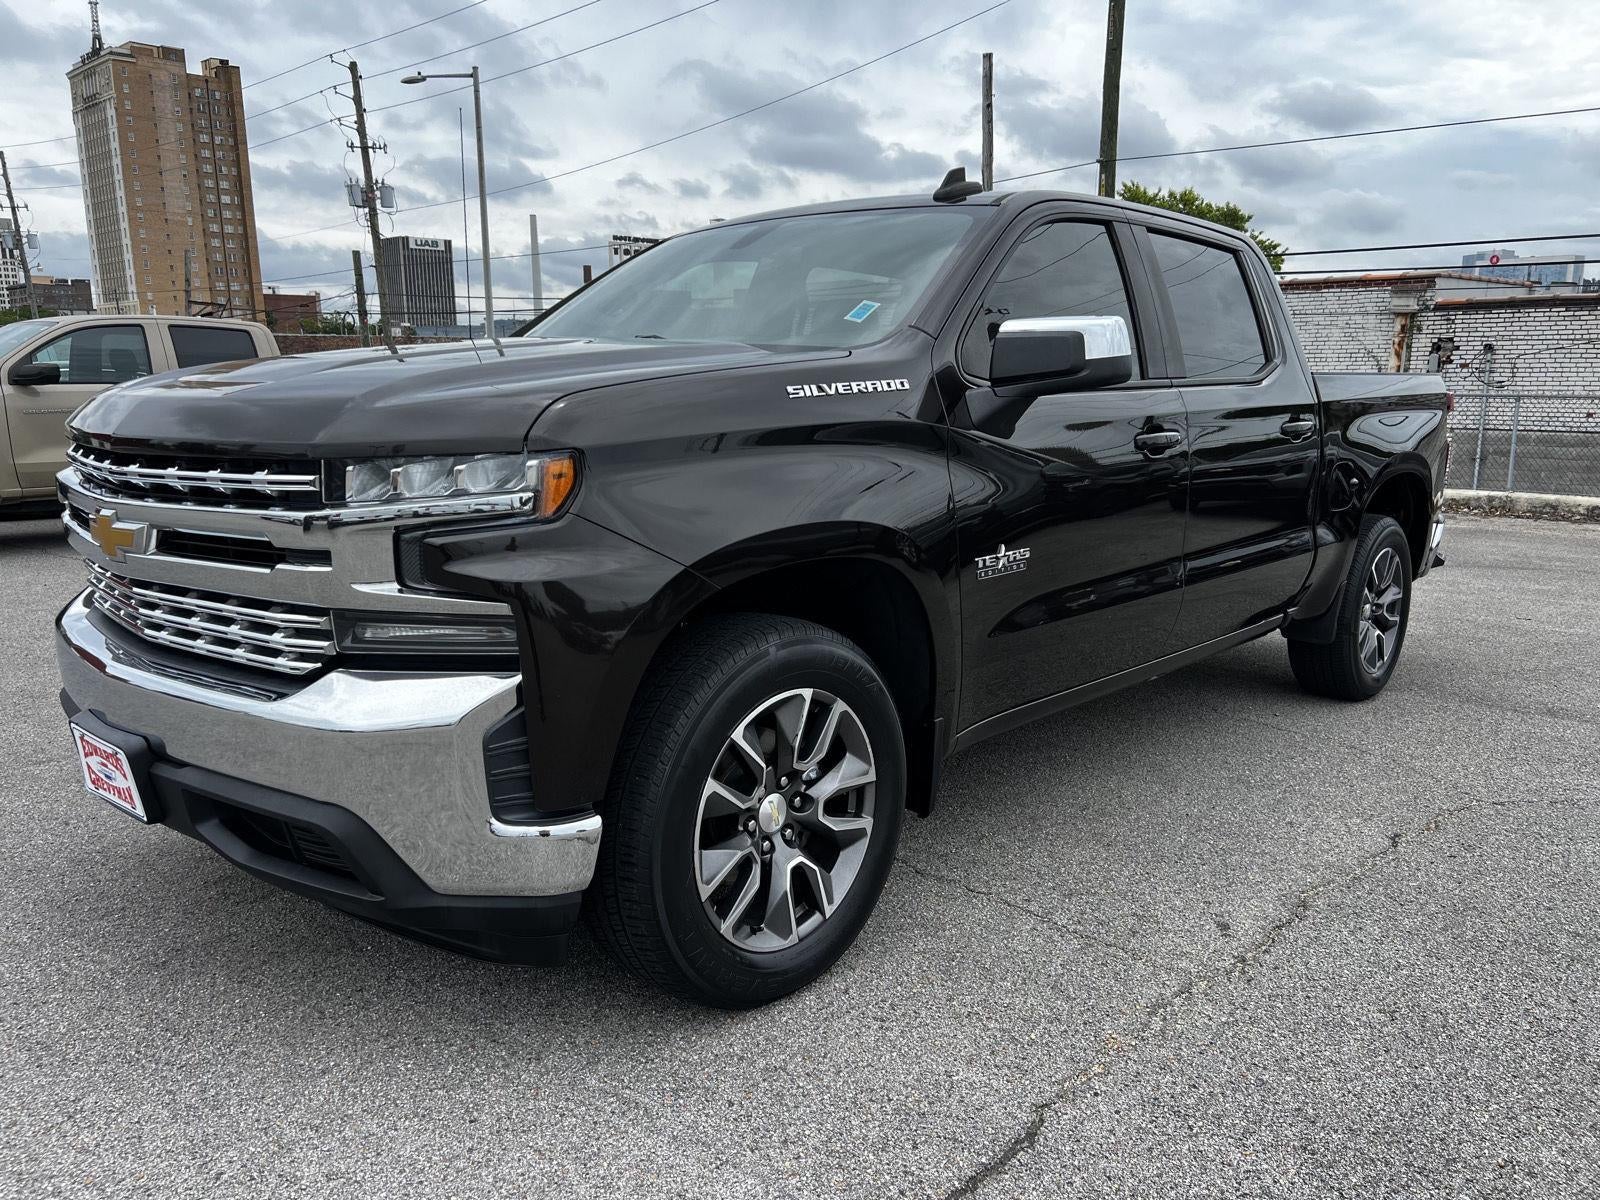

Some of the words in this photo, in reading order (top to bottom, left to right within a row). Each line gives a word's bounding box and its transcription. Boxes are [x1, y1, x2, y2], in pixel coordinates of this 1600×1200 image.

[415, 239, 439, 248] UAB
[786, 378, 910, 399] SILVERADO
[974, 544, 1031, 569] TEXAS
[981, 563, 1025, 577] EDITION
